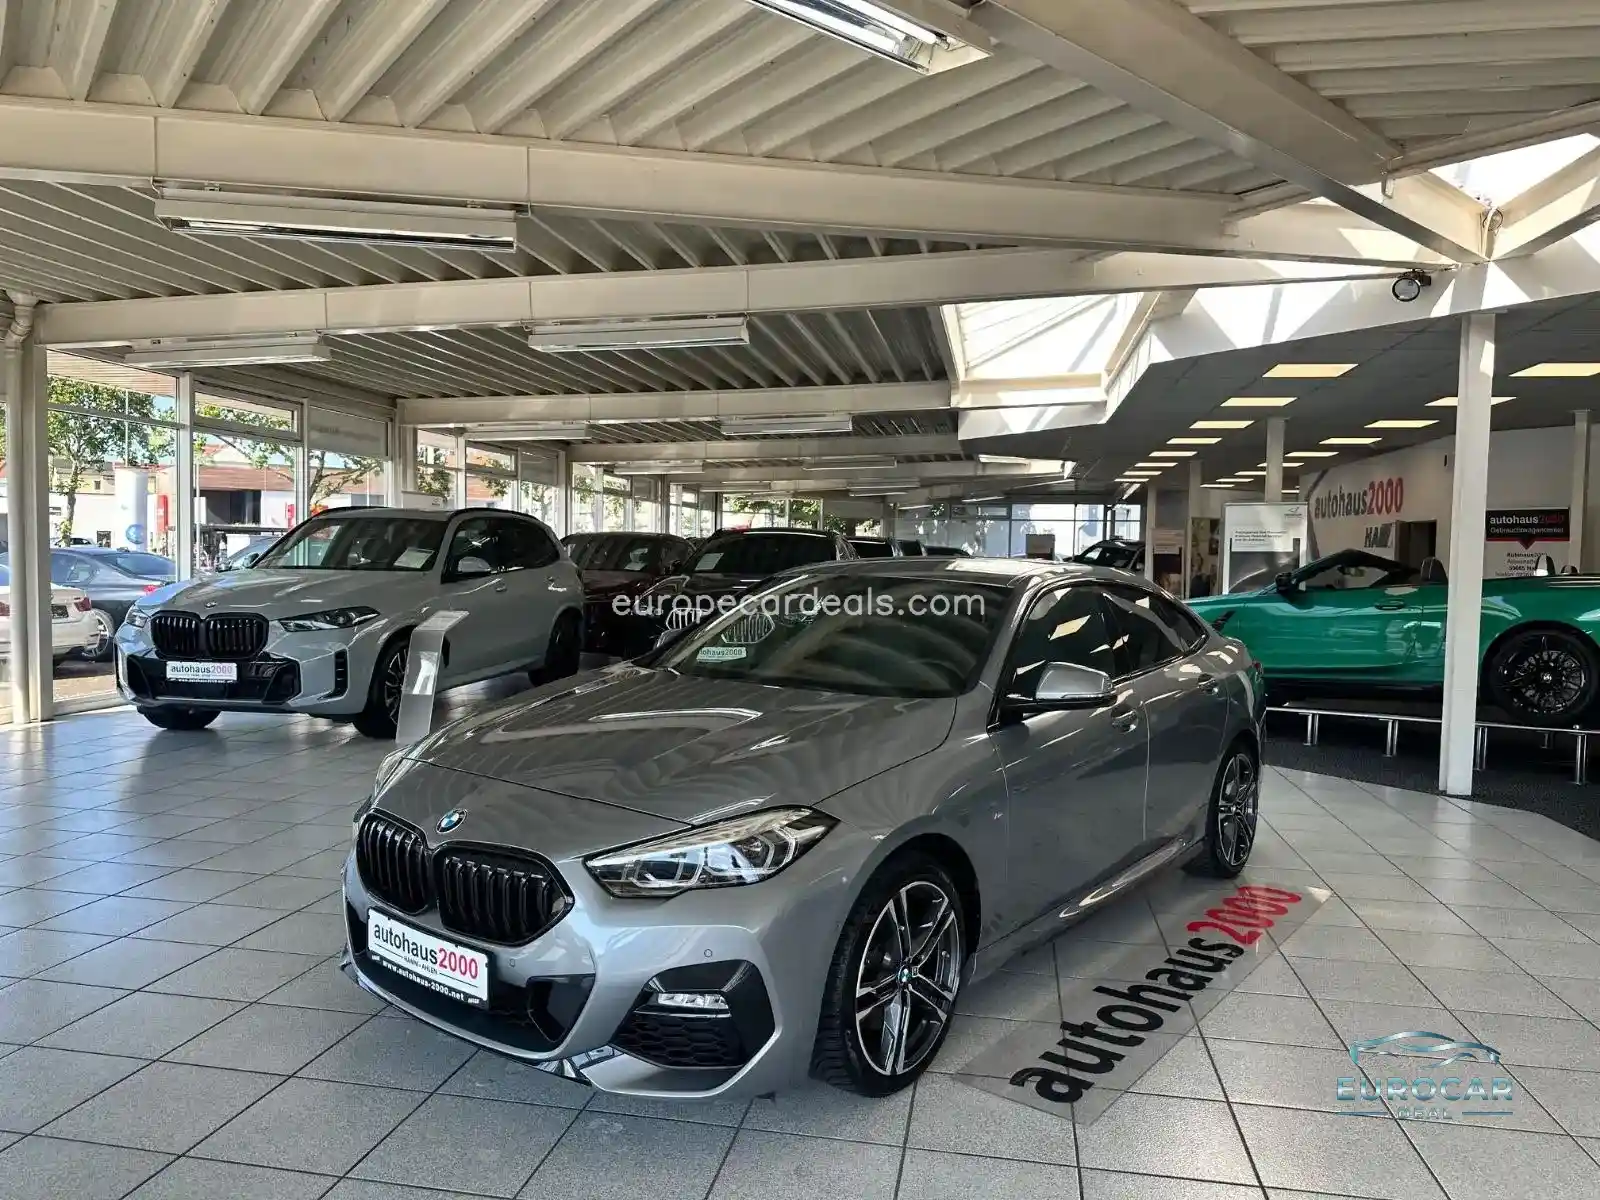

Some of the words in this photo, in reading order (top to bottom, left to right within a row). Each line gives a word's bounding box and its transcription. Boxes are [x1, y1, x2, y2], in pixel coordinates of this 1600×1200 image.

[1315, 477, 1404, 519] autohaus2000
[171, 665, 233, 674] autohaus2000
[374, 924, 479, 980] autohaus2000
[382, 960, 465, 1001] www.autohaus-2000.net
[1008, 885, 1303, 1103] autohaus2000
